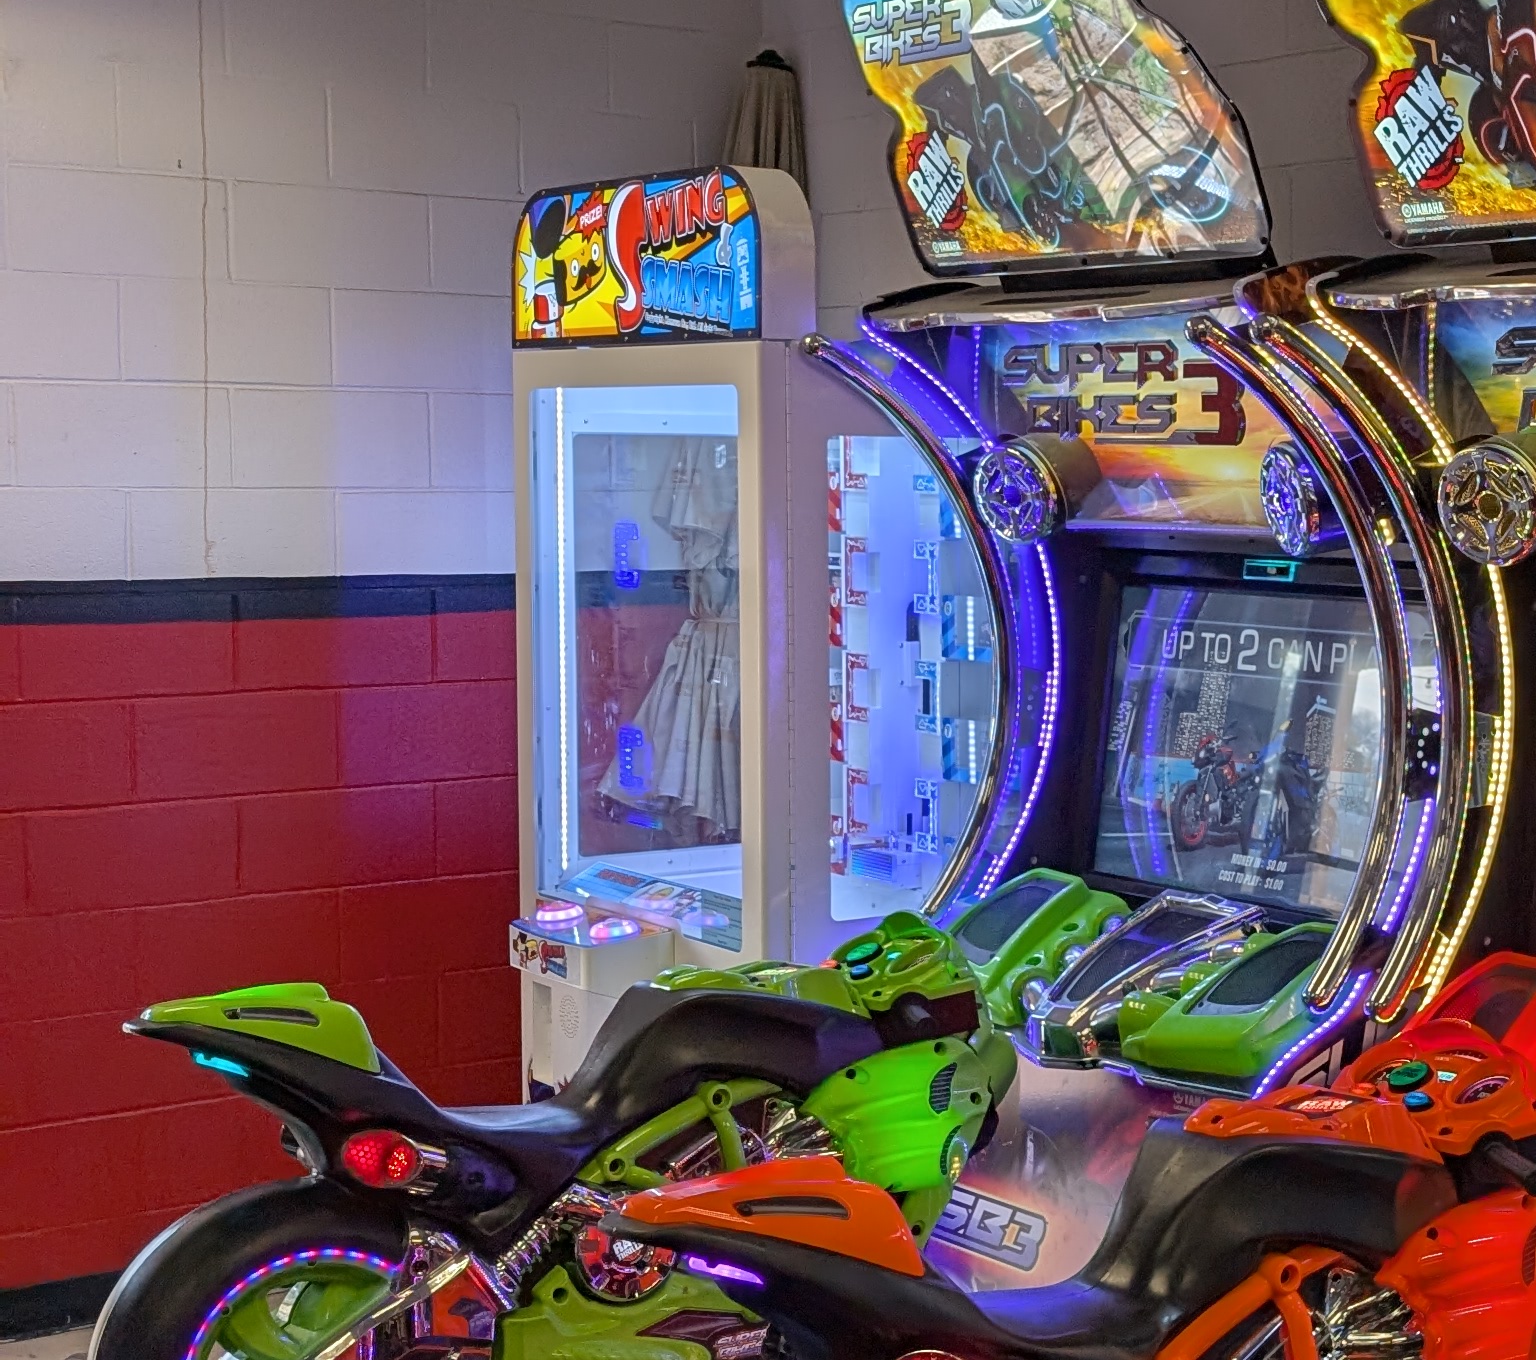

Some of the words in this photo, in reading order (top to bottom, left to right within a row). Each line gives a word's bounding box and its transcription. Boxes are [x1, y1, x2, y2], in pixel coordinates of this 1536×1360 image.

[864, 24, 941, 68] BIKES
[1374, 65, 1447, 167] RAW
[907, 130, 953, 212] RAW
[1398, 106, 1464, 188] THRILLS
[579, 202, 604, 228] PRIZE!
[926, 163, 965, 229] THRILLS
[1411, 202, 1445, 216] YAMAHA
[641, 257, 735, 323] SMASH
[1003, 337, 1179, 390] SUPER
[1027, 394, 1177, 441] BIKES
[1183, 358, 1245, 445] 3
[1162, 629, 1195, 660] UP
[1200, 632, 1232, 665] TO
[1237, 629, 1260, 672] 2
[1268, 637, 1323, 674] CAN
[1219, 869, 1236, 882] COST
